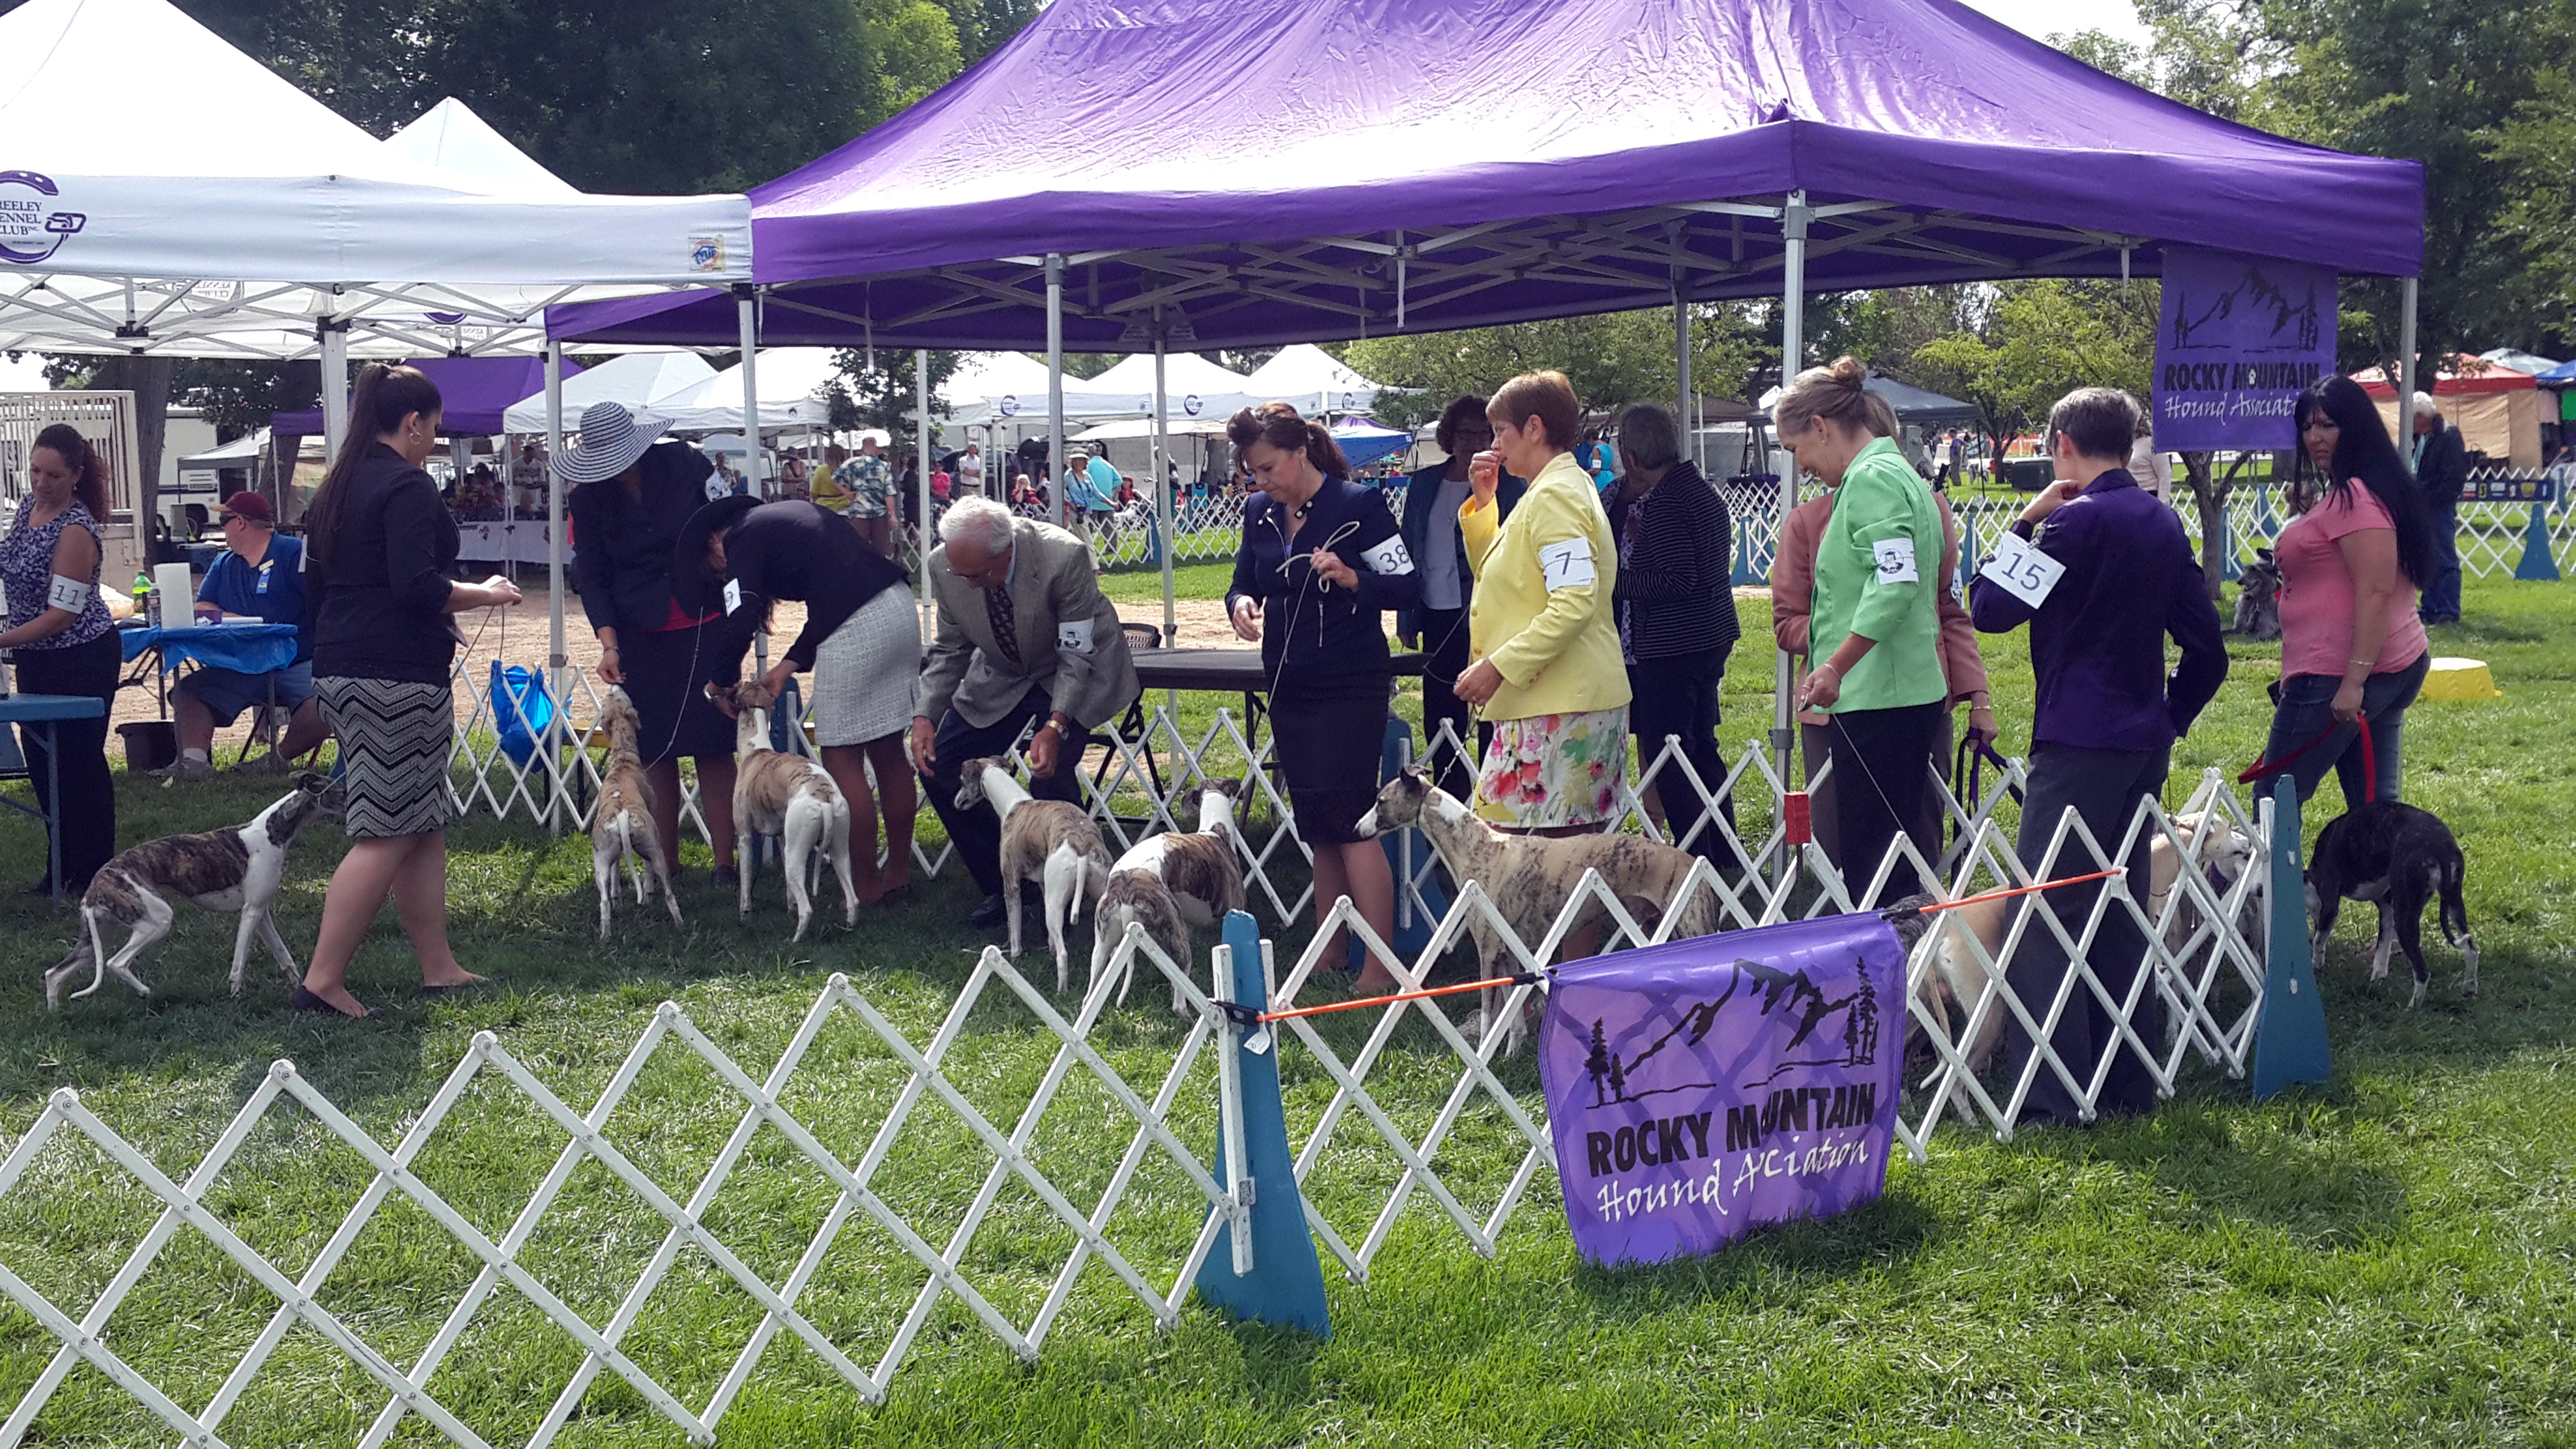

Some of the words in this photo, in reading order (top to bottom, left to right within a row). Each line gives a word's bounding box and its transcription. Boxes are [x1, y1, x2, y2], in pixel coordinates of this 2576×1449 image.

[2164, 363, 2228, 392] ROCKY
[2164, 391, 2228, 426] Hound
[1379, 544, 1410, 573] 38
[1555, 551, 1571, 575] 7
[2001, 552, 2047, 591] 15
[54, 584, 79, 606] 11
[1586, 1111, 1712, 1178] ROCKY
[1596, 1158, 1729, 1222] Hound
